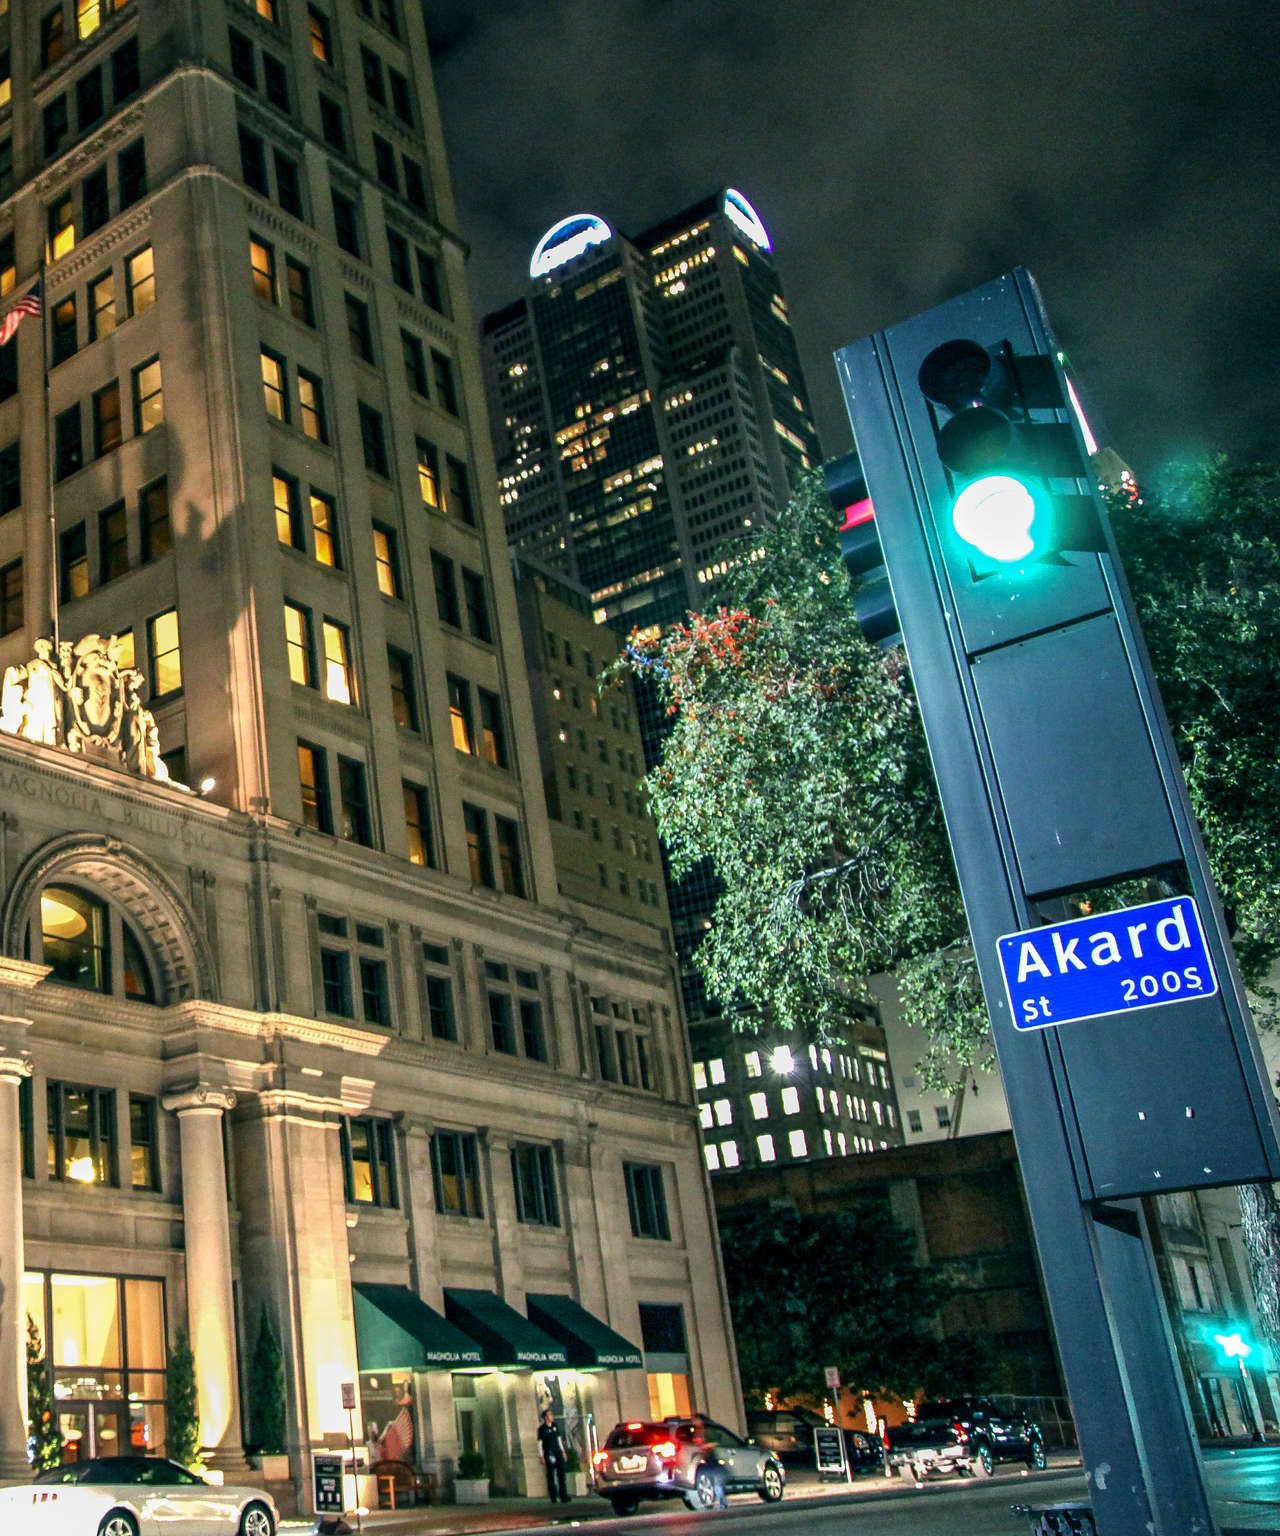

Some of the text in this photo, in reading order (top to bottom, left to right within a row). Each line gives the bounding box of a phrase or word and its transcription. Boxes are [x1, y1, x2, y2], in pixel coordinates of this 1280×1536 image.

[1017, 904, 1192, 983] Akard
[1022, 966, 1203, 1022] St 200S
[427, 1352, 481, 1362] MAGNOLIA HOTEL
[517, 1352, 566, 1362] MAGNOLIA HOTEL
[598, 1355, 642, 1364] MAGNOLIA HOTEL
